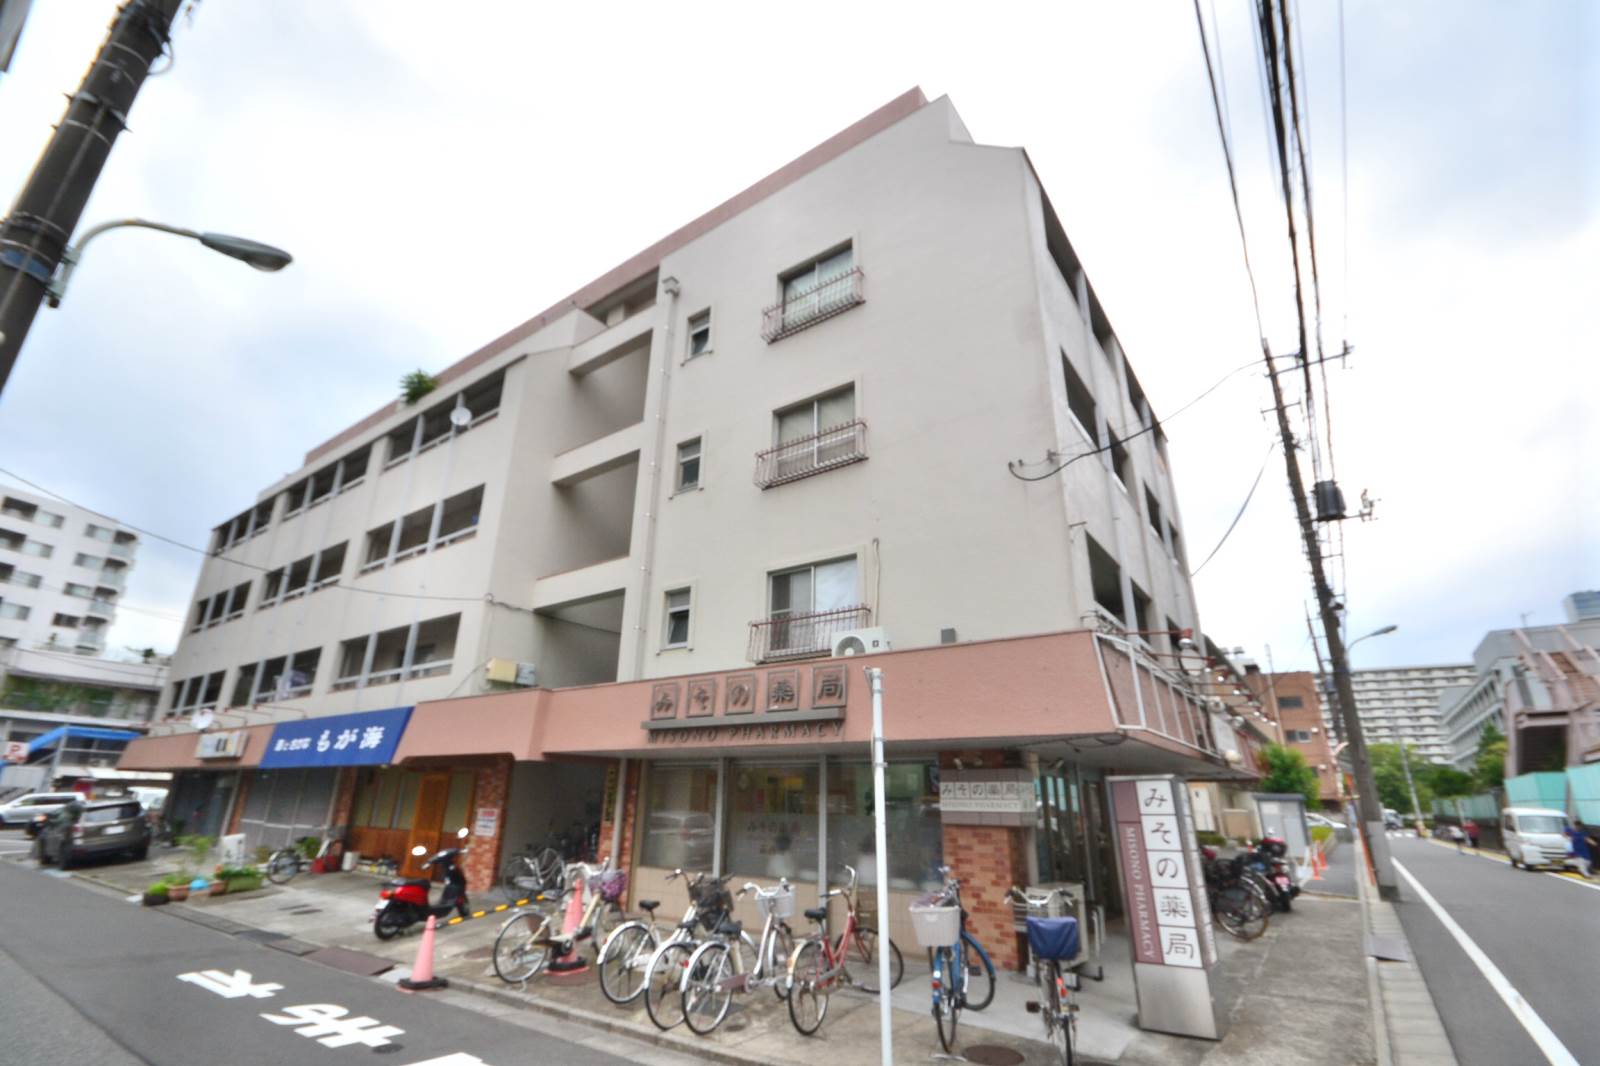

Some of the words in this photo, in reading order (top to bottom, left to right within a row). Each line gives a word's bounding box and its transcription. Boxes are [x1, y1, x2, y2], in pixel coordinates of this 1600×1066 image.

[654, 676, 844, 712] みその薬局
[316, 726, 385, 752] もが海
[648, 728, 719, 745] MISONO
[727, 722, 844, 741] PHARMACY
[1126, 827, 1143, 881] MISONO
[1143, 788, 1195, 960] みその薬局
[1134, 884, 1156, 959] PHARMACY
